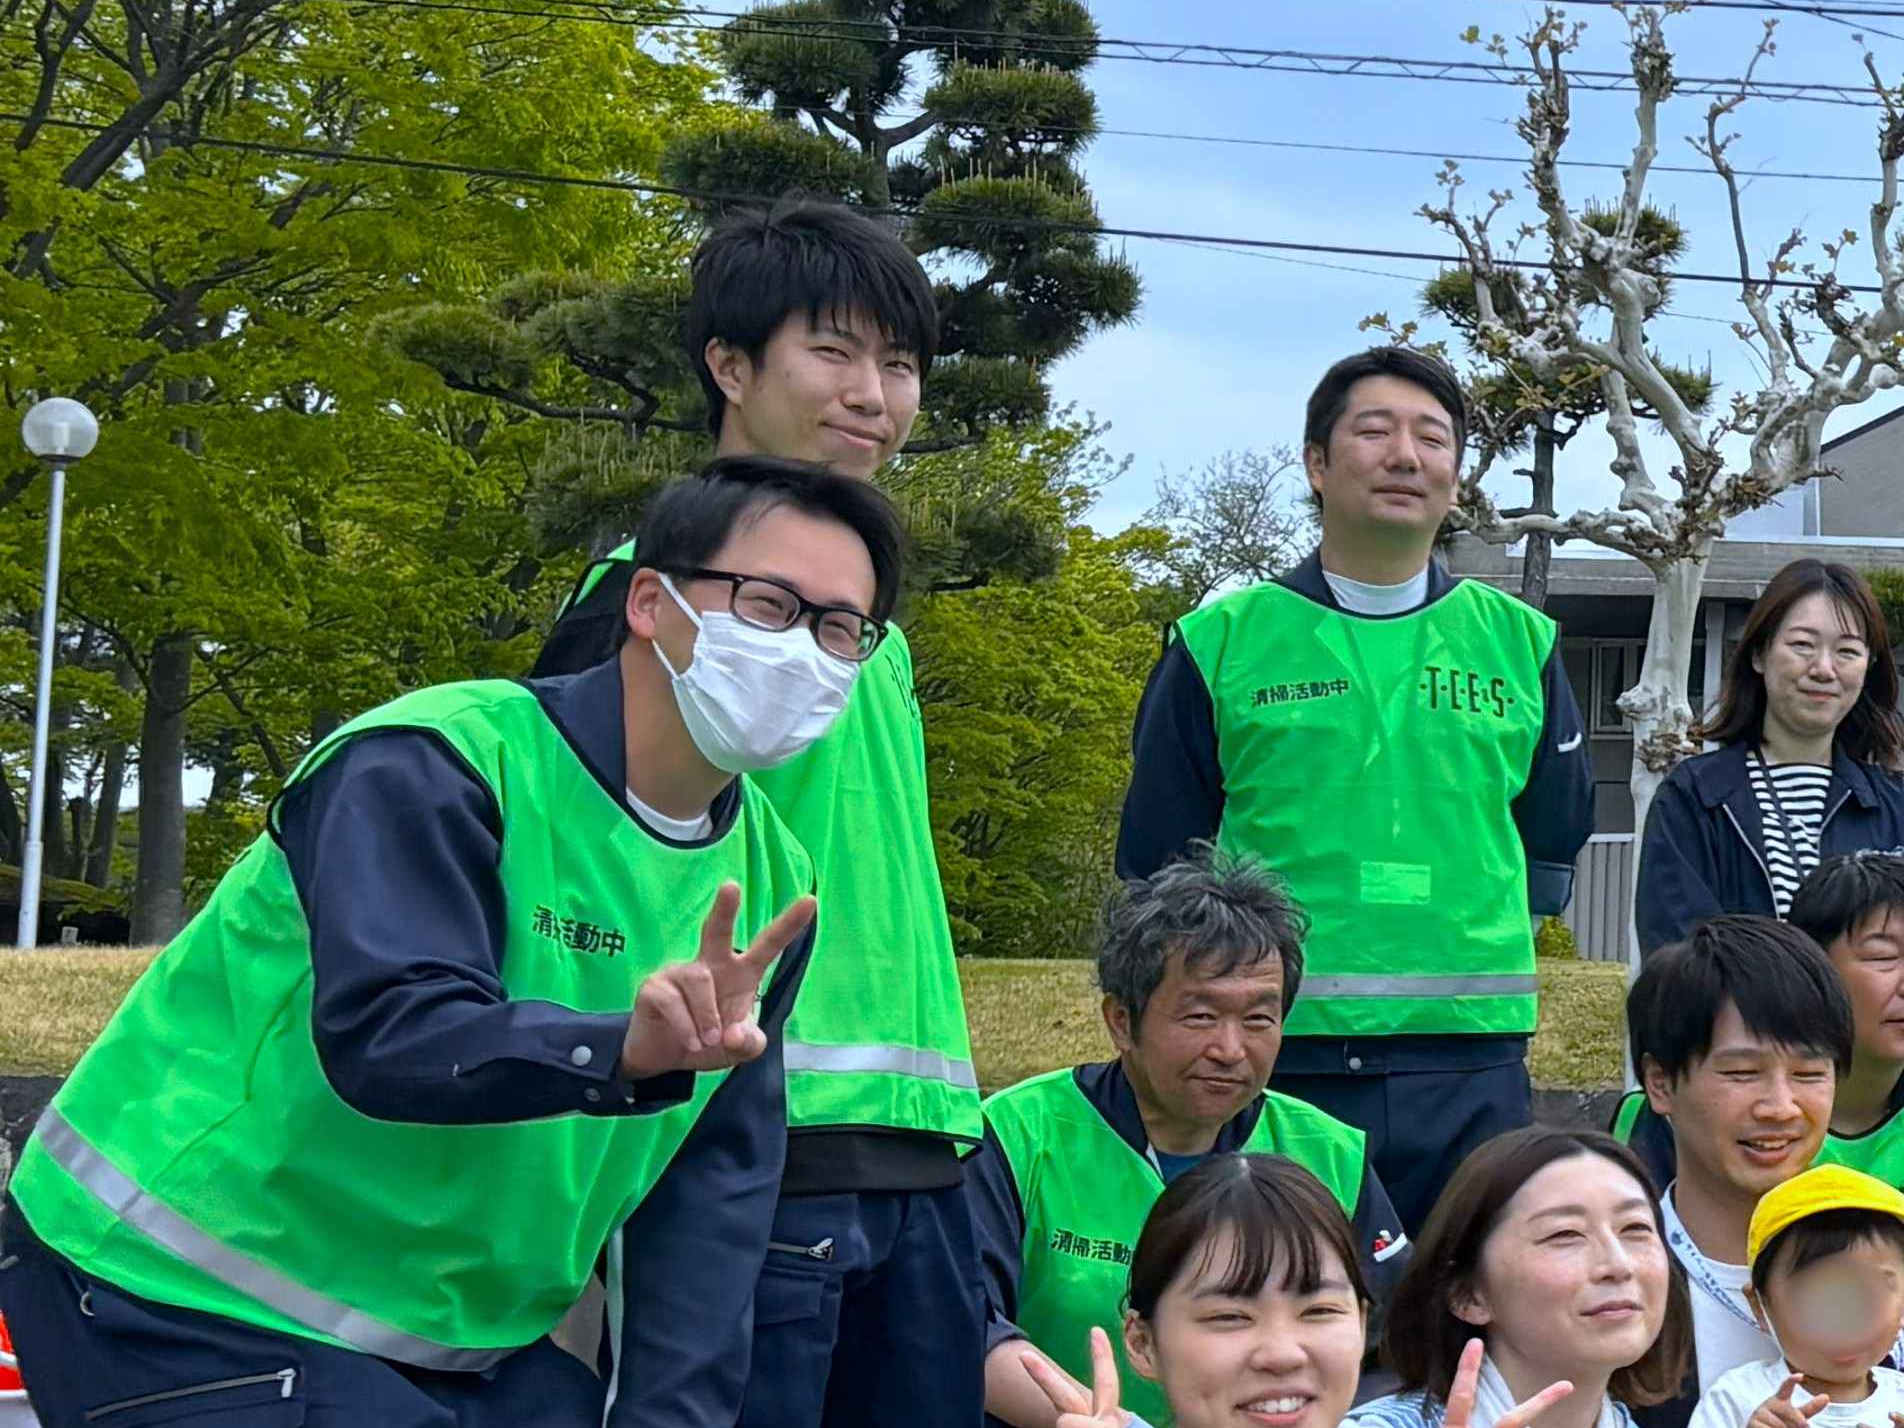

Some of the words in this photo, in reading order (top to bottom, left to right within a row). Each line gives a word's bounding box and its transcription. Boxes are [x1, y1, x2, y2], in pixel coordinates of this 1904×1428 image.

[1251, 678, 1349, 707] 清掃活動中
